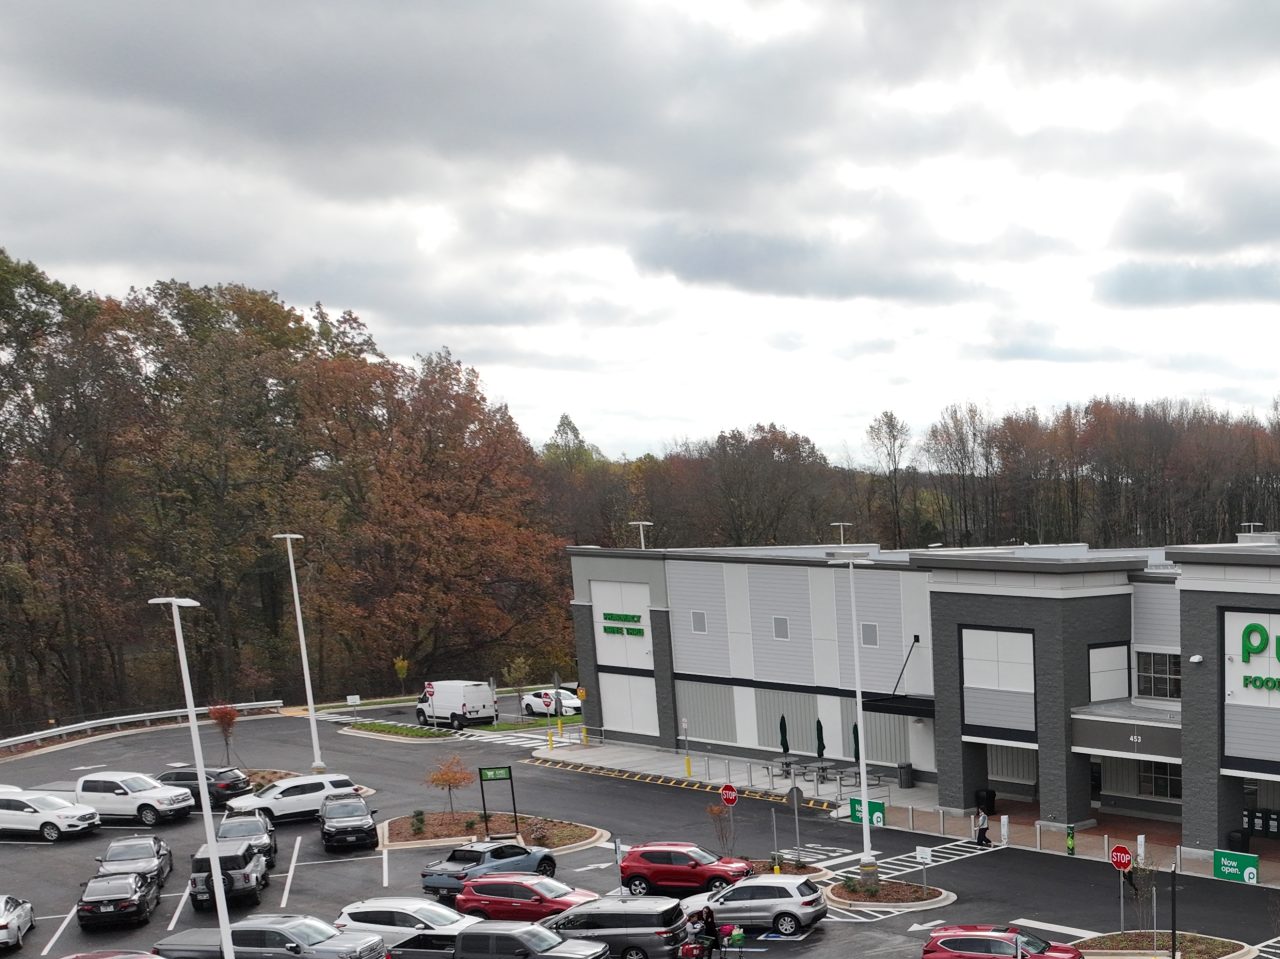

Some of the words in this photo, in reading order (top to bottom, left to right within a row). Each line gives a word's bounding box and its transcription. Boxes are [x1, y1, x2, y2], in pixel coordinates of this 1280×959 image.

[722, 791, 736, 799] STOP
[1112, 852, 1130, 863] STOP
[1221, 857, 1237, 867] Now
[1221, 866, 1240, 874] open.
